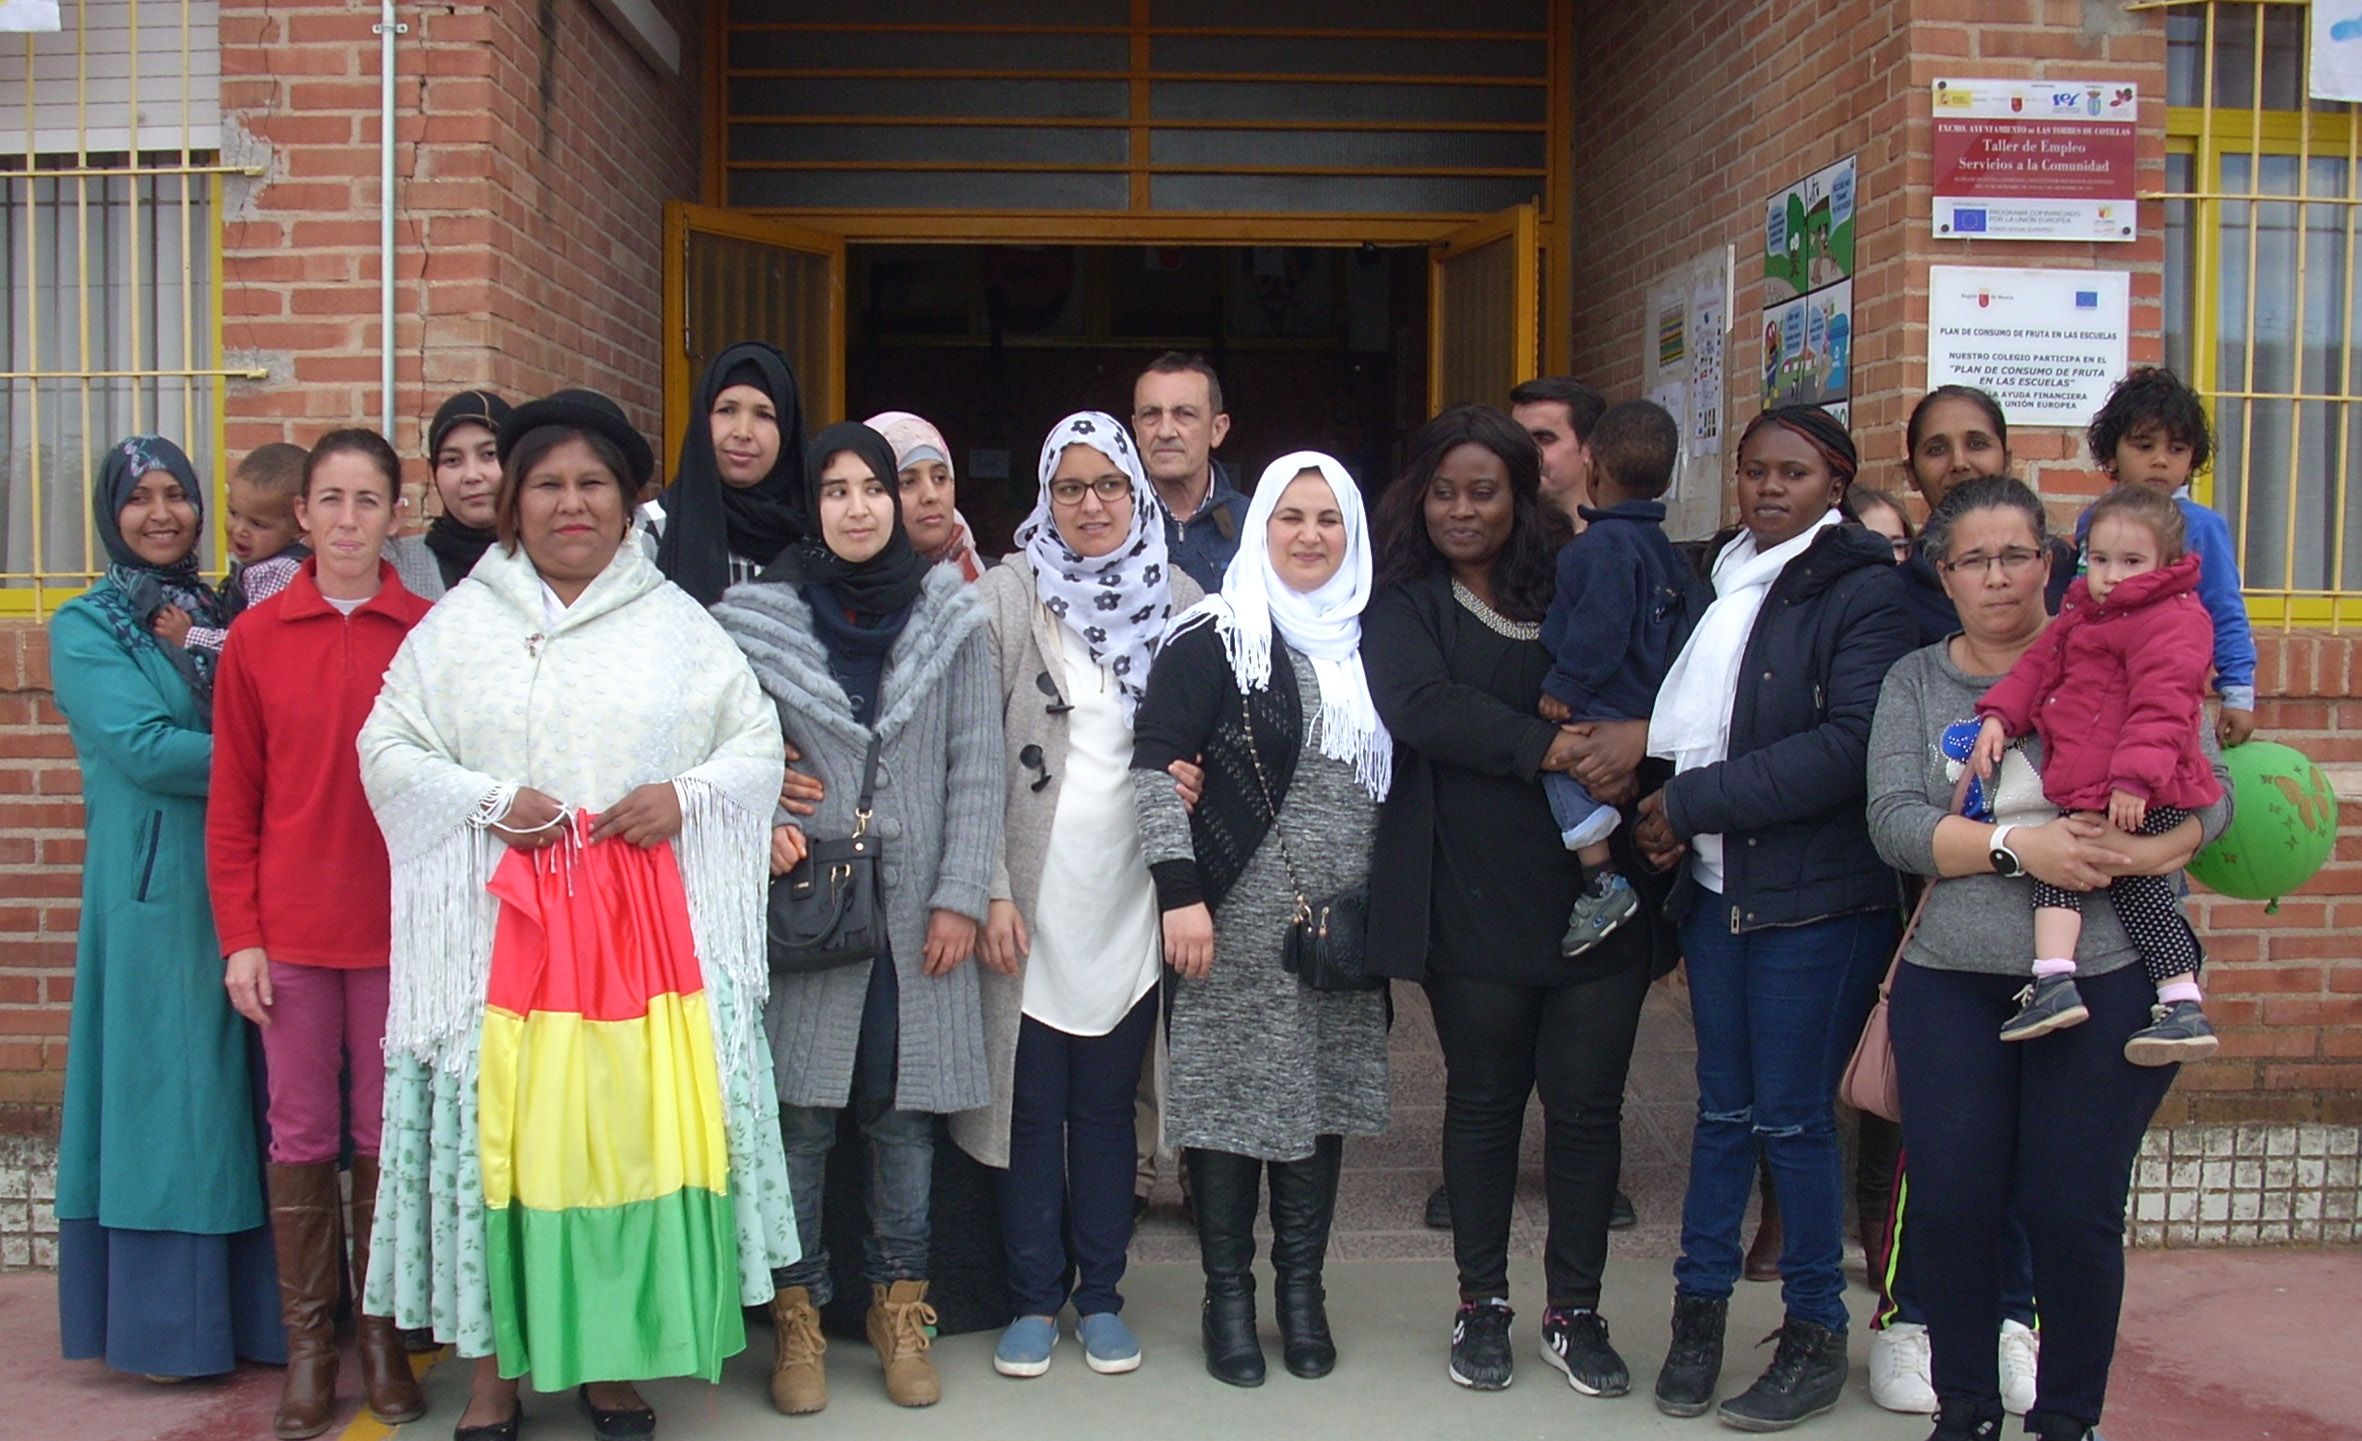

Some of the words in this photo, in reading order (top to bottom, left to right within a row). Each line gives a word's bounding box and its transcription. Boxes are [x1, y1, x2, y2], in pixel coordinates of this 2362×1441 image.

[1969, 124, 2027, 134] AYUNTAMIENTO
[2037, 126, 2050, 134] LAS
[2053, 126, 2081, 135] TORRES
[2083, 127, 2092, 135] DE
[2094, 127, 2130, 136] COTILLAS
[1983, 138, 2018, 152] Taller
[2022, 139, 2037, 152] de
[2040, 140, 2086, 157] Empleo
[1958, 157, 2013, 170] Servicios
[2027, 158, 2038, 171] la
[2041, 159, 2110, 172] Comunidad
[1973, 328, 2011, 337] CONSUMO
[2013, 329, 2023, 337] DE
[2025, 330, 2050, 338] FRUTA
[2064, 331, 2077, 339] LAS
[2080, 331, 2117, 340] ESCUELAS
[1949, 352, 1990, 360] NUESTRO
[1992, 353, 2031, 361] COLEGIO
[2033, 354, 2080, 363] PARTICIPA
[2083, 355, 2095, 363] EN
[2097, 356, 2106, 364] EL
[1950, 364, 1982, 374] "PLAN
[1984, 365, 1998, 374] DE
[2000, 366, 2052, 376] CONSUMO
[2055, 368, 2069, 376] DE
[2072, 368, 2105, 377] FRUTA
[1979, 377, 1993, 385] EN
[1996, 377, 2015, 386] LAS
[2018, 378, 2075, 387] ESCUELAS"
[2001, 391, 2031, 399] AYUDA
[2033, 392, 2087, 400] FINANCIERA
[2004, 399, 2034, 408] UNIÓN
[2037, 401, 2077, 409] EUROPEA
